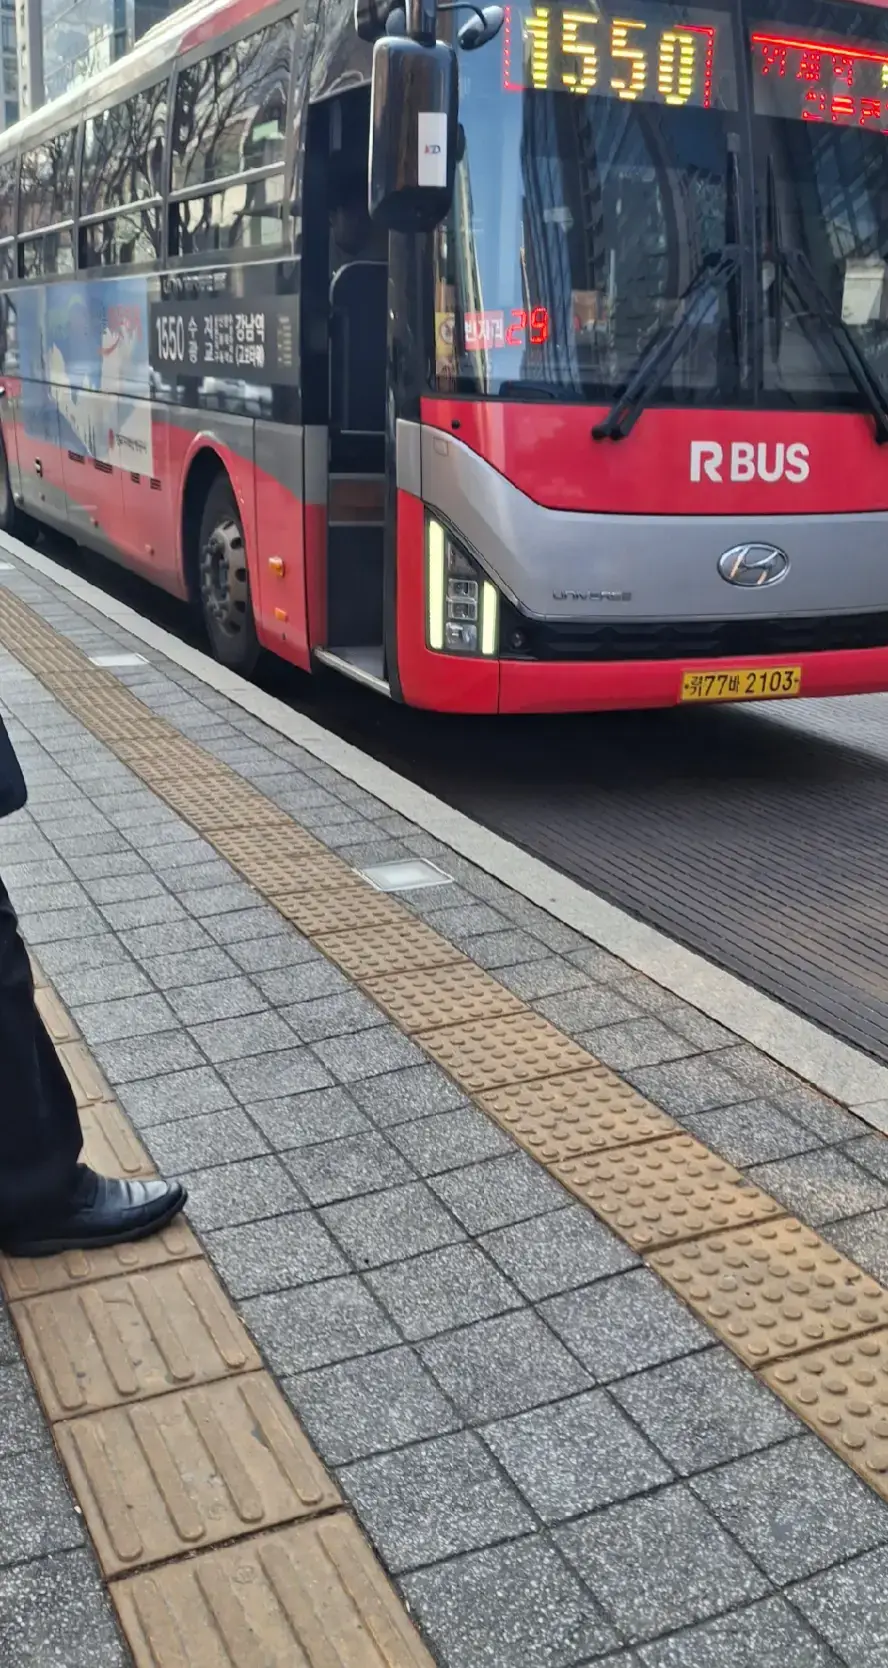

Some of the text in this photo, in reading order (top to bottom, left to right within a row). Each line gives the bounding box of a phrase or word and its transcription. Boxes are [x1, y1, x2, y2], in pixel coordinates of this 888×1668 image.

[525, 7, 696, 105] 1550
[156, 315, 184, 361] 1550
[235, 313, 265, 342] 강남역
[506, 307, 548, 345] 29
[690, 440, 810, 483] R BUS
[745, 670, 795, 693] 2103
